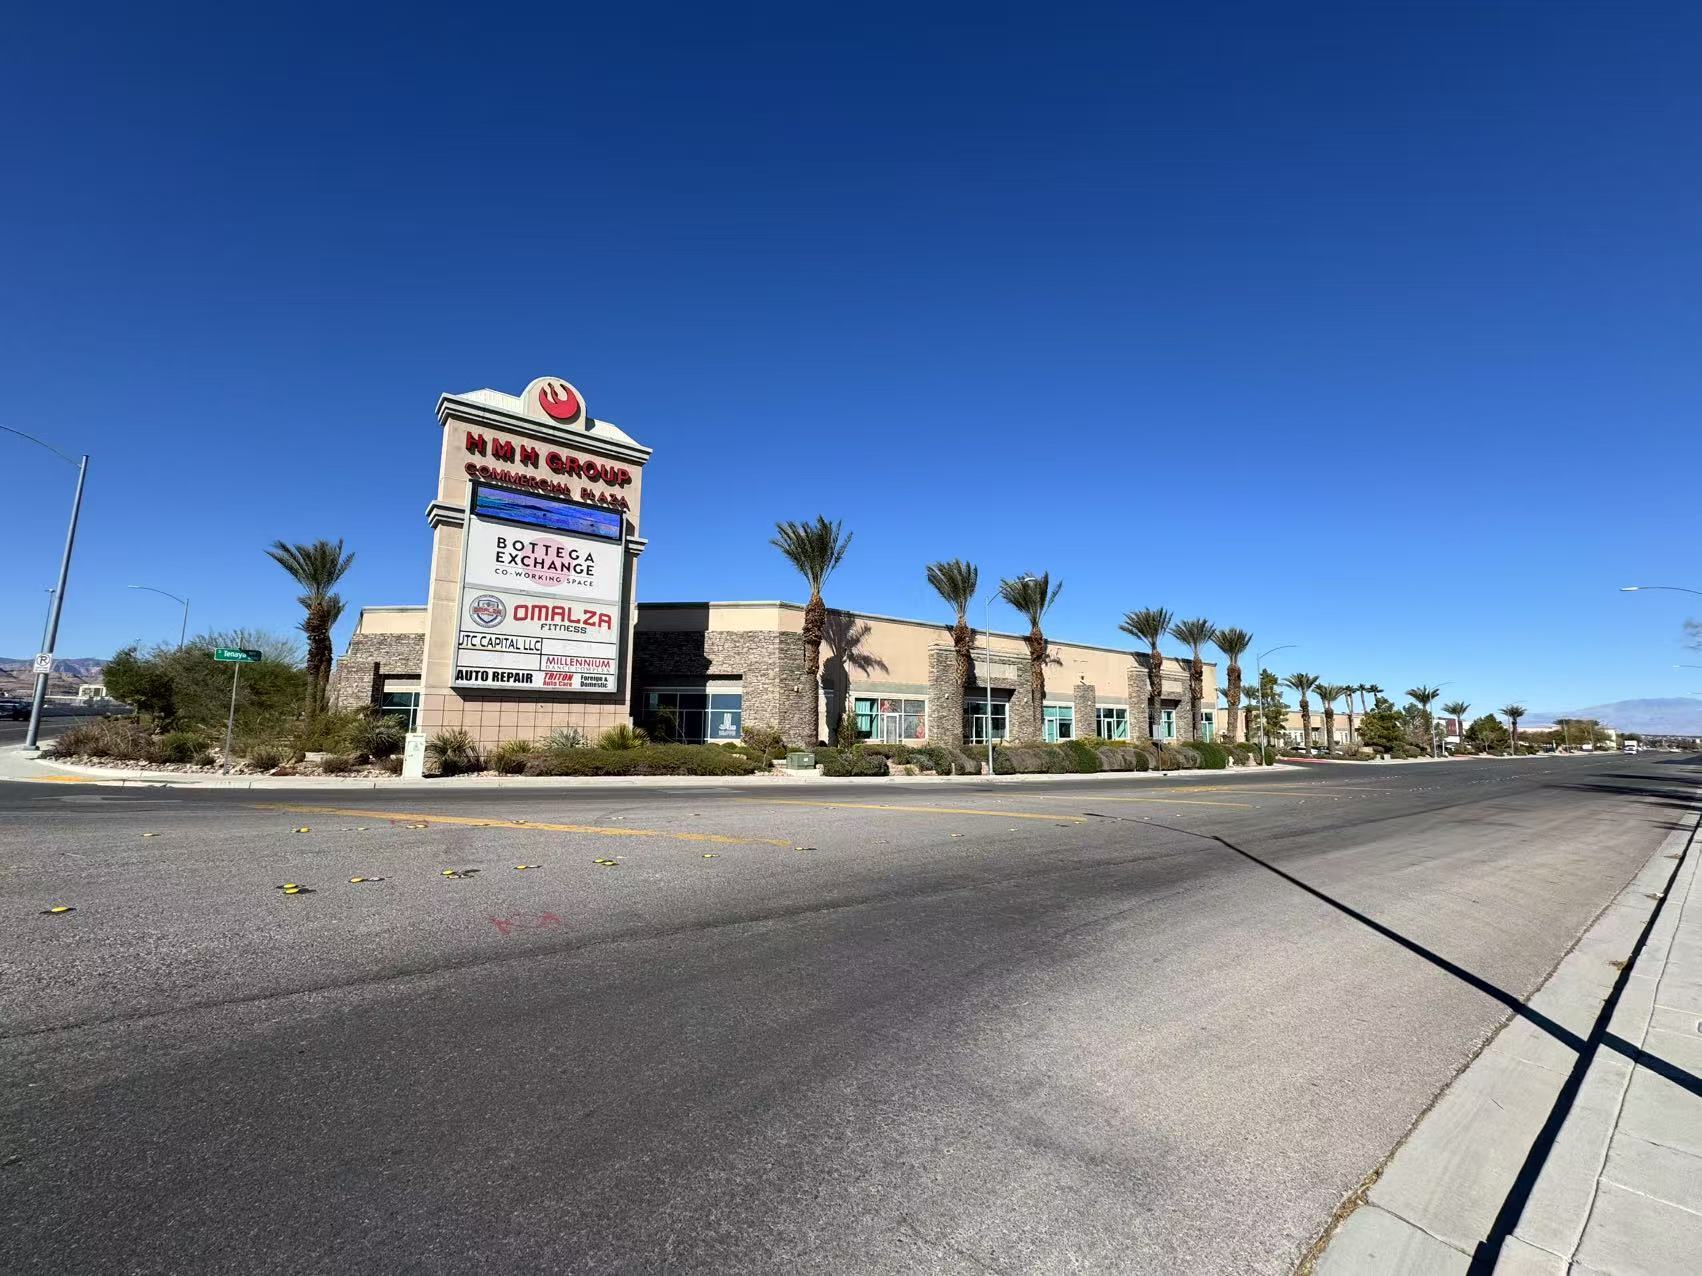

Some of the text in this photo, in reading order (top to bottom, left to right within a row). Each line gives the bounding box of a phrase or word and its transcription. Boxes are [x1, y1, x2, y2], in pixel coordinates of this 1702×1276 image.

[545, 451, 632, 488] GROUP
[464, 461, 631, 511] COMMERCIAL PLAZA
[496, 536, 595, 563] BOTTEGA
[495, 551, 595, 577] EXCHANGE
[494, 568, 594, 587] CO-WORKING SPACE
[513, 604, 612, 631] OMALZA
[540, 623, 587, 635] FITNESS
[479, 635, 521, 650] CAPITAL
[523, 639, 541, 652] LLC
[224, 650, 247, 659] Tenaya
[545, 656, 611, 669] MILLENNIUM
[456, 670, 533, 684] AUTO REPAIR
[543, 672, 574, 682] TRITON
[580, 681, 609, 689] Domestic
